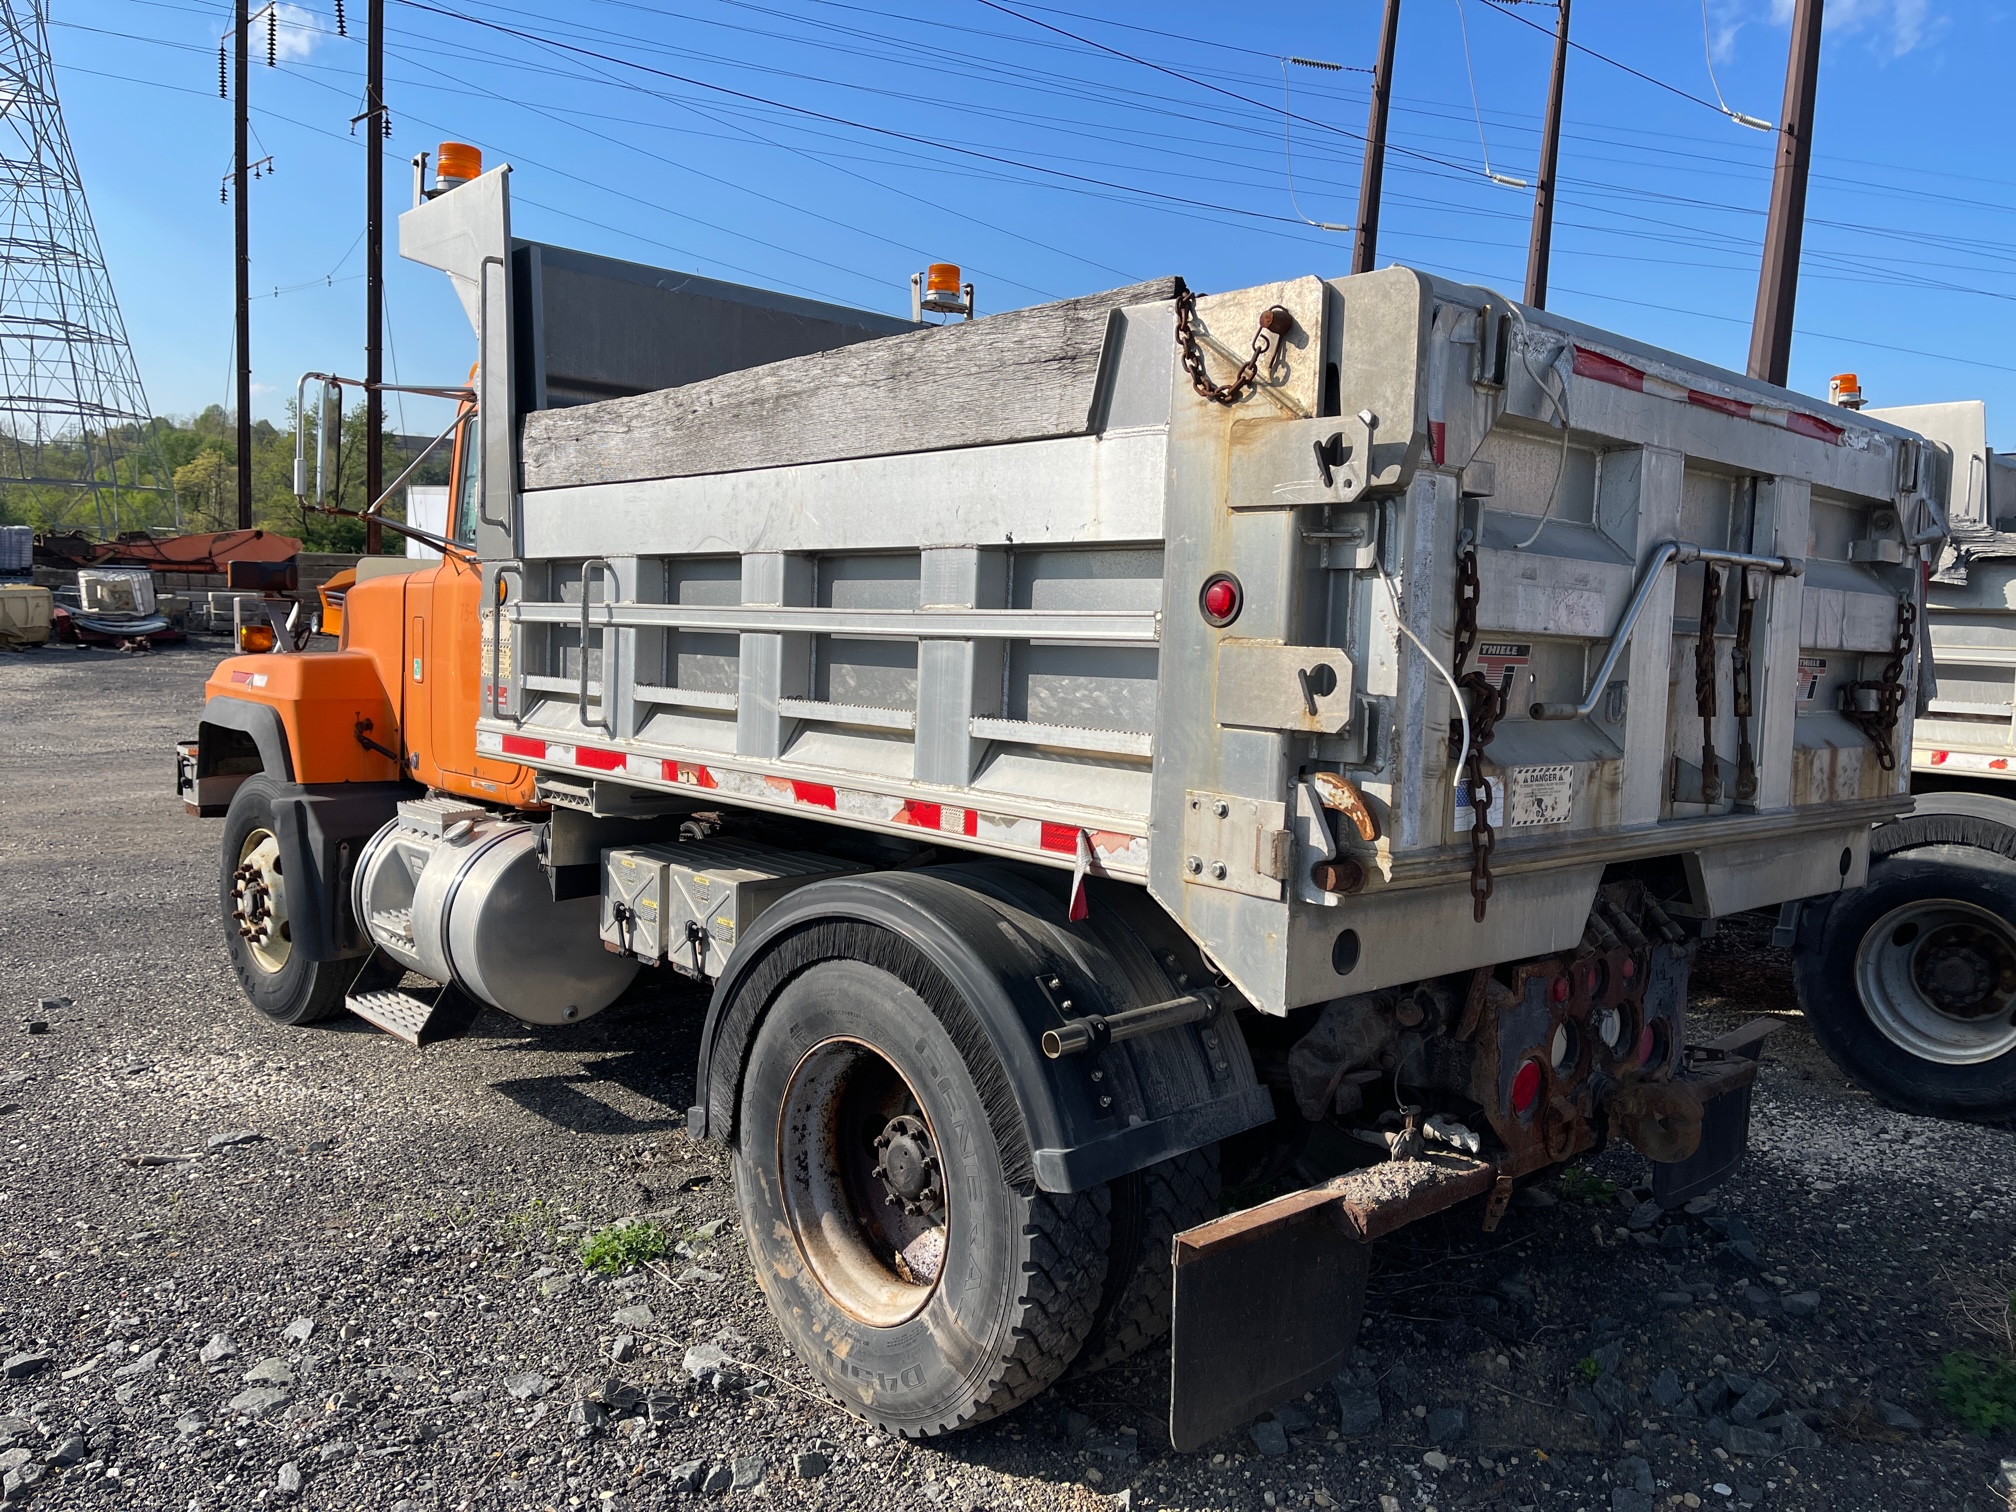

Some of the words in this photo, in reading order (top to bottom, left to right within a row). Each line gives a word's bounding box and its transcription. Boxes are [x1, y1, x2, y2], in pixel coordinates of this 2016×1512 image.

[1481, 645, 1518, 655] THIELE
[1530, 773, 1557, 783] DANGER
[914, 1037, 986, 1324] GENERAL
